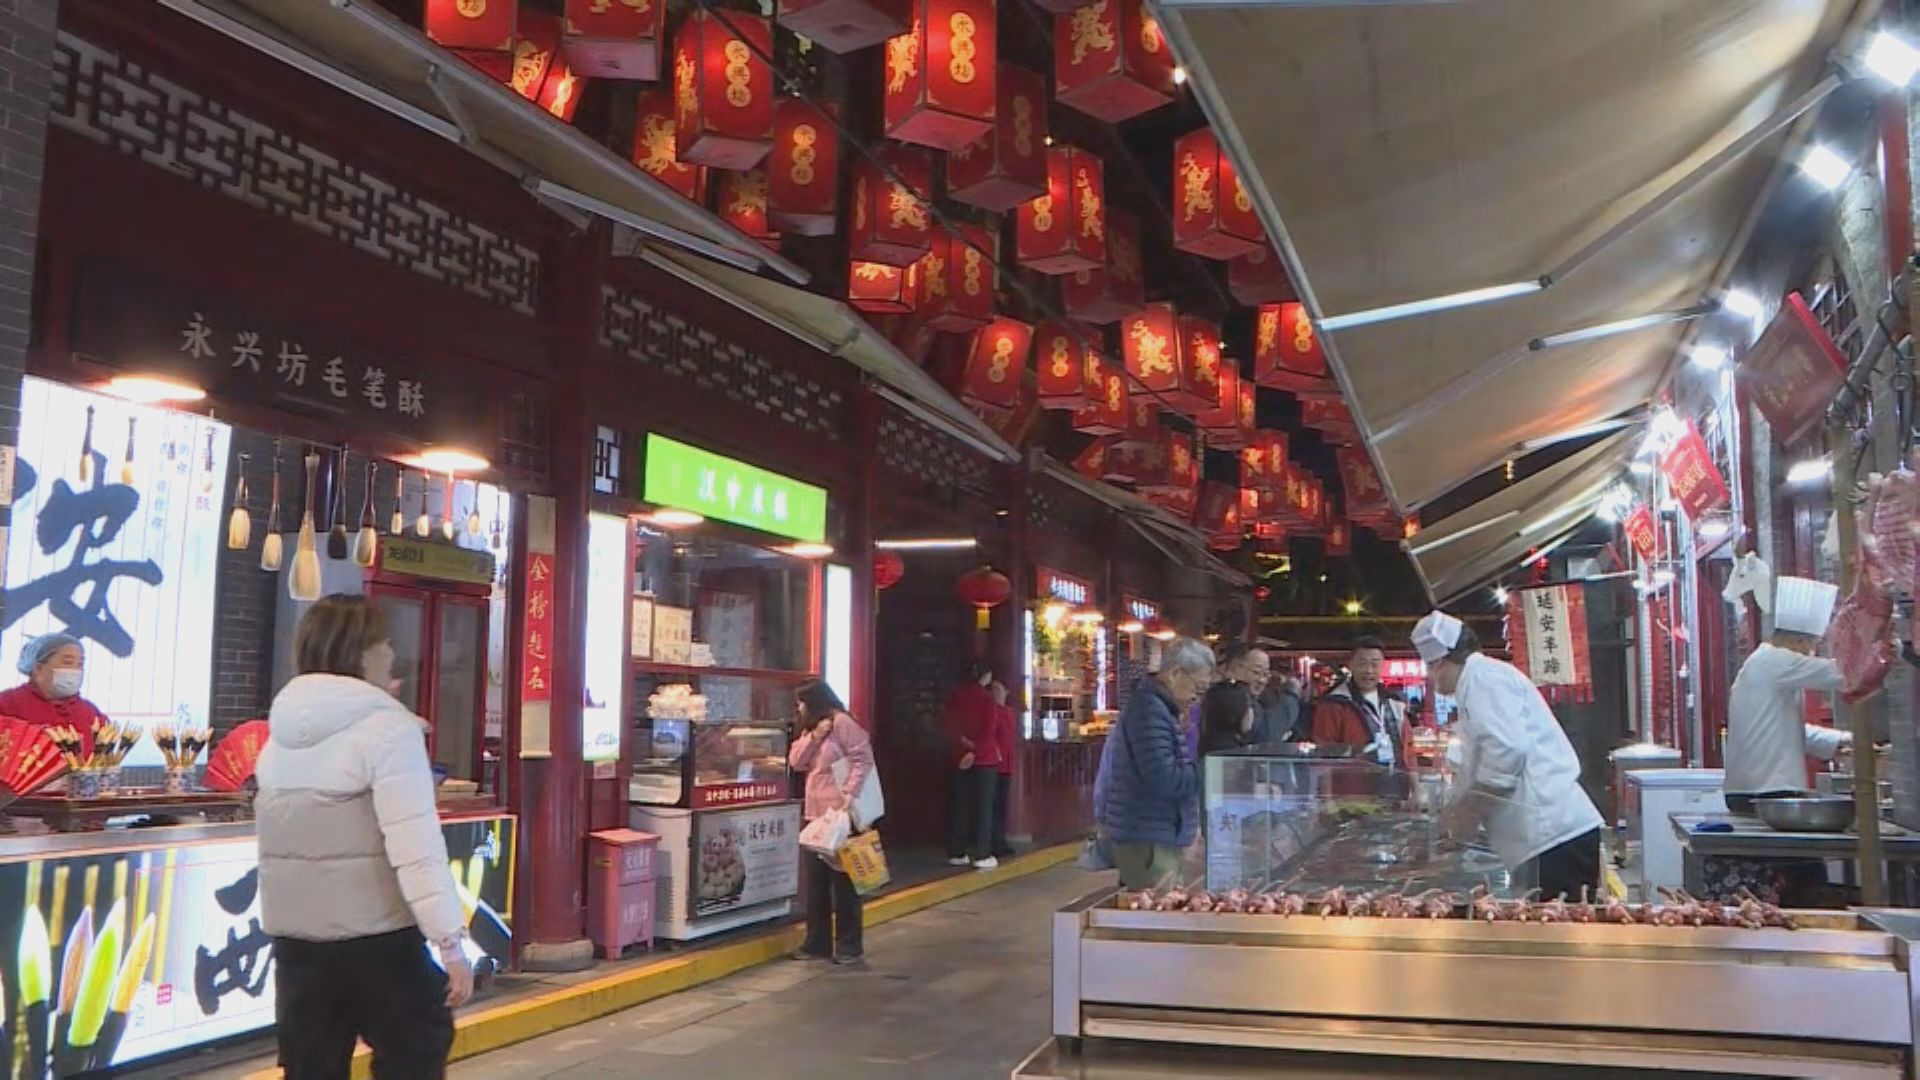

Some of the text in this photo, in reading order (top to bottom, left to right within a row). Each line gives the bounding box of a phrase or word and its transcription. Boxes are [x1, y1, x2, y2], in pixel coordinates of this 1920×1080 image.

[180, 311, 426, 419] 永兴坊毛笔酥
